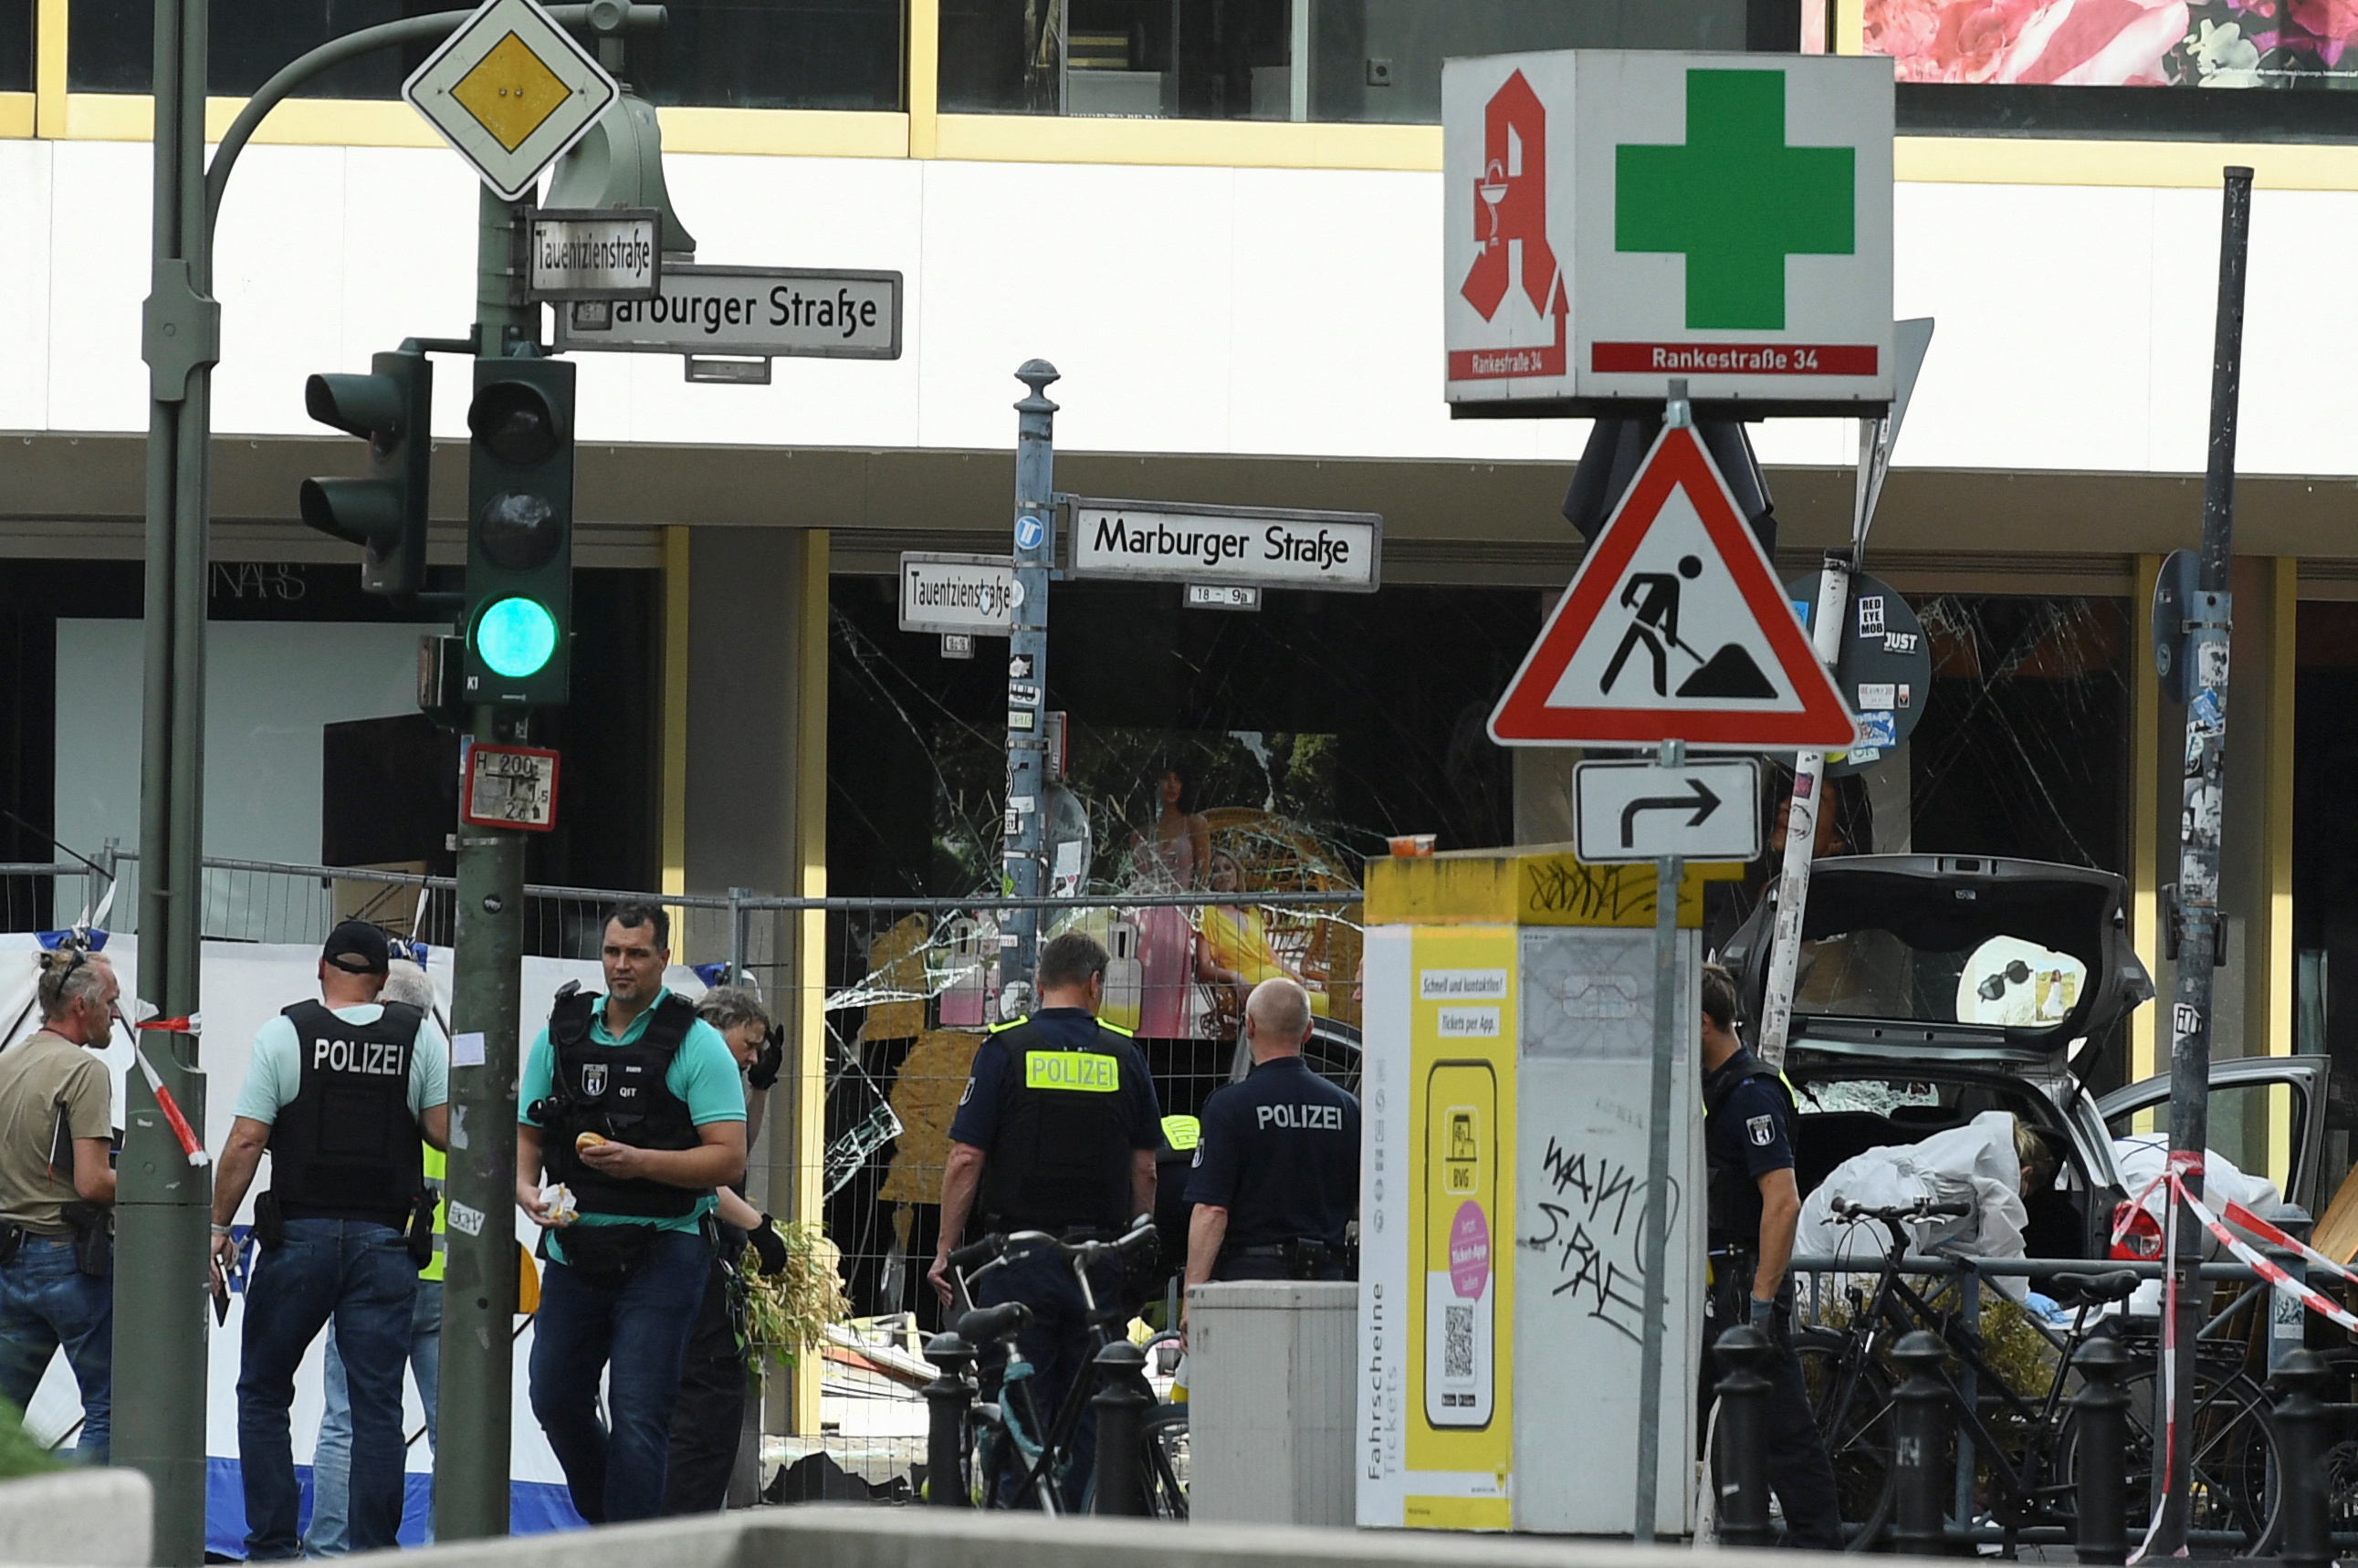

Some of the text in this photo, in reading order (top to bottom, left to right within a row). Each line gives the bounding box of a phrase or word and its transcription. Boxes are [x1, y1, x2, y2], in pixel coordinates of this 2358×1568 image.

[536, 228, 649, 278] Tauentzienstraße
[615, 294, 757, 335] arburger
[769, 285, 877, 339] Straße
[1472, 350, 1542, 374] Rankestraße 34
[1651, 347, 1818, 371] Rankestraße 34
[1094, 517, 1250, 566] Marburger
[1263, 525, 1349, 570] Straße
[1197, 587, 1210, 601] 18
[1862, 599, 1881, 611] RED
[1863, 612, 1881, 622] EYE
[1861, 623, 1883, 635] MOB
[1884, 632, 1918, 650] JUST
[466, 675, 479, 690] K1
[476, 752, 534, 776] H 200
[1423, 977, 1449, 994] Schnell
[1450, 977, 1462, 993] und
[1442, 1014, 1495, 1035] Tickets per App.
[313, 1038, 404, 1076] POLIZEI
[1032, 1057, 1115, 1087] POLIZEI
[619, 1086, 637, 1098] QIT
[1256, 1103, 1343, 1131] POLIZEI
[1453, 1167, 1470, 1188] BVG
[1451, 1244, 1487, 1265] Ticket-App
[1368, 1282, 1384, 1480] Fahrscheine
[1383, 1365, 1398, 1479] Tickets
